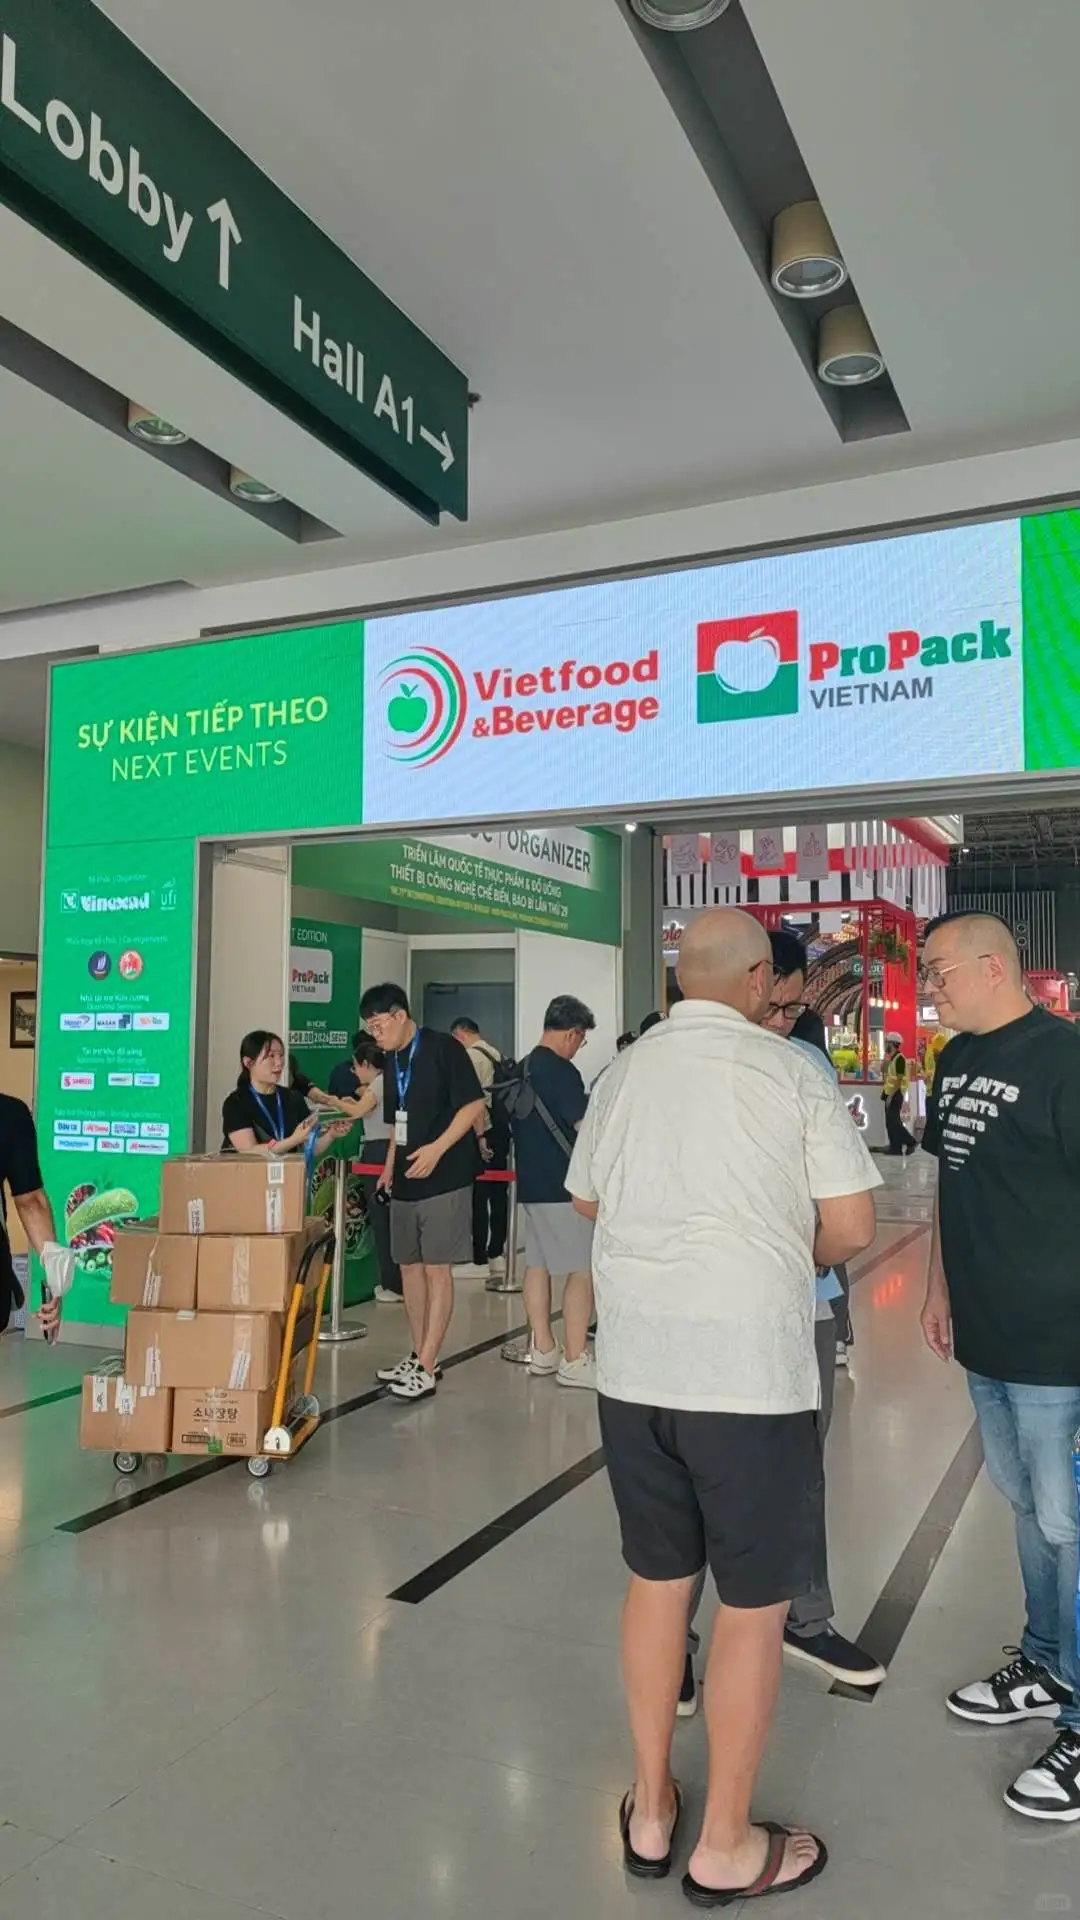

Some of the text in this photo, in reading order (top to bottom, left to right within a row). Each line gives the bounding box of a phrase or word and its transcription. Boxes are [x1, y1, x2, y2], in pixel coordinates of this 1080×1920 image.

[1, 33, 193, 263] Lobby
[293, 295, 414, 444] Hall A1
[473, 649, 659, 701] Vietfood
[809, 620, 1012, 682] ProPack
[809, 677, 933, 710] VIETNAM
[77, 695, 329, 752] SỰ KIỆN TIẾP THEO
[112, 740, 288, 782] NEXT EVENTS
[507, 829, 591, 873] ORGANIZER
[292, 969, 329, 984] ProPack
